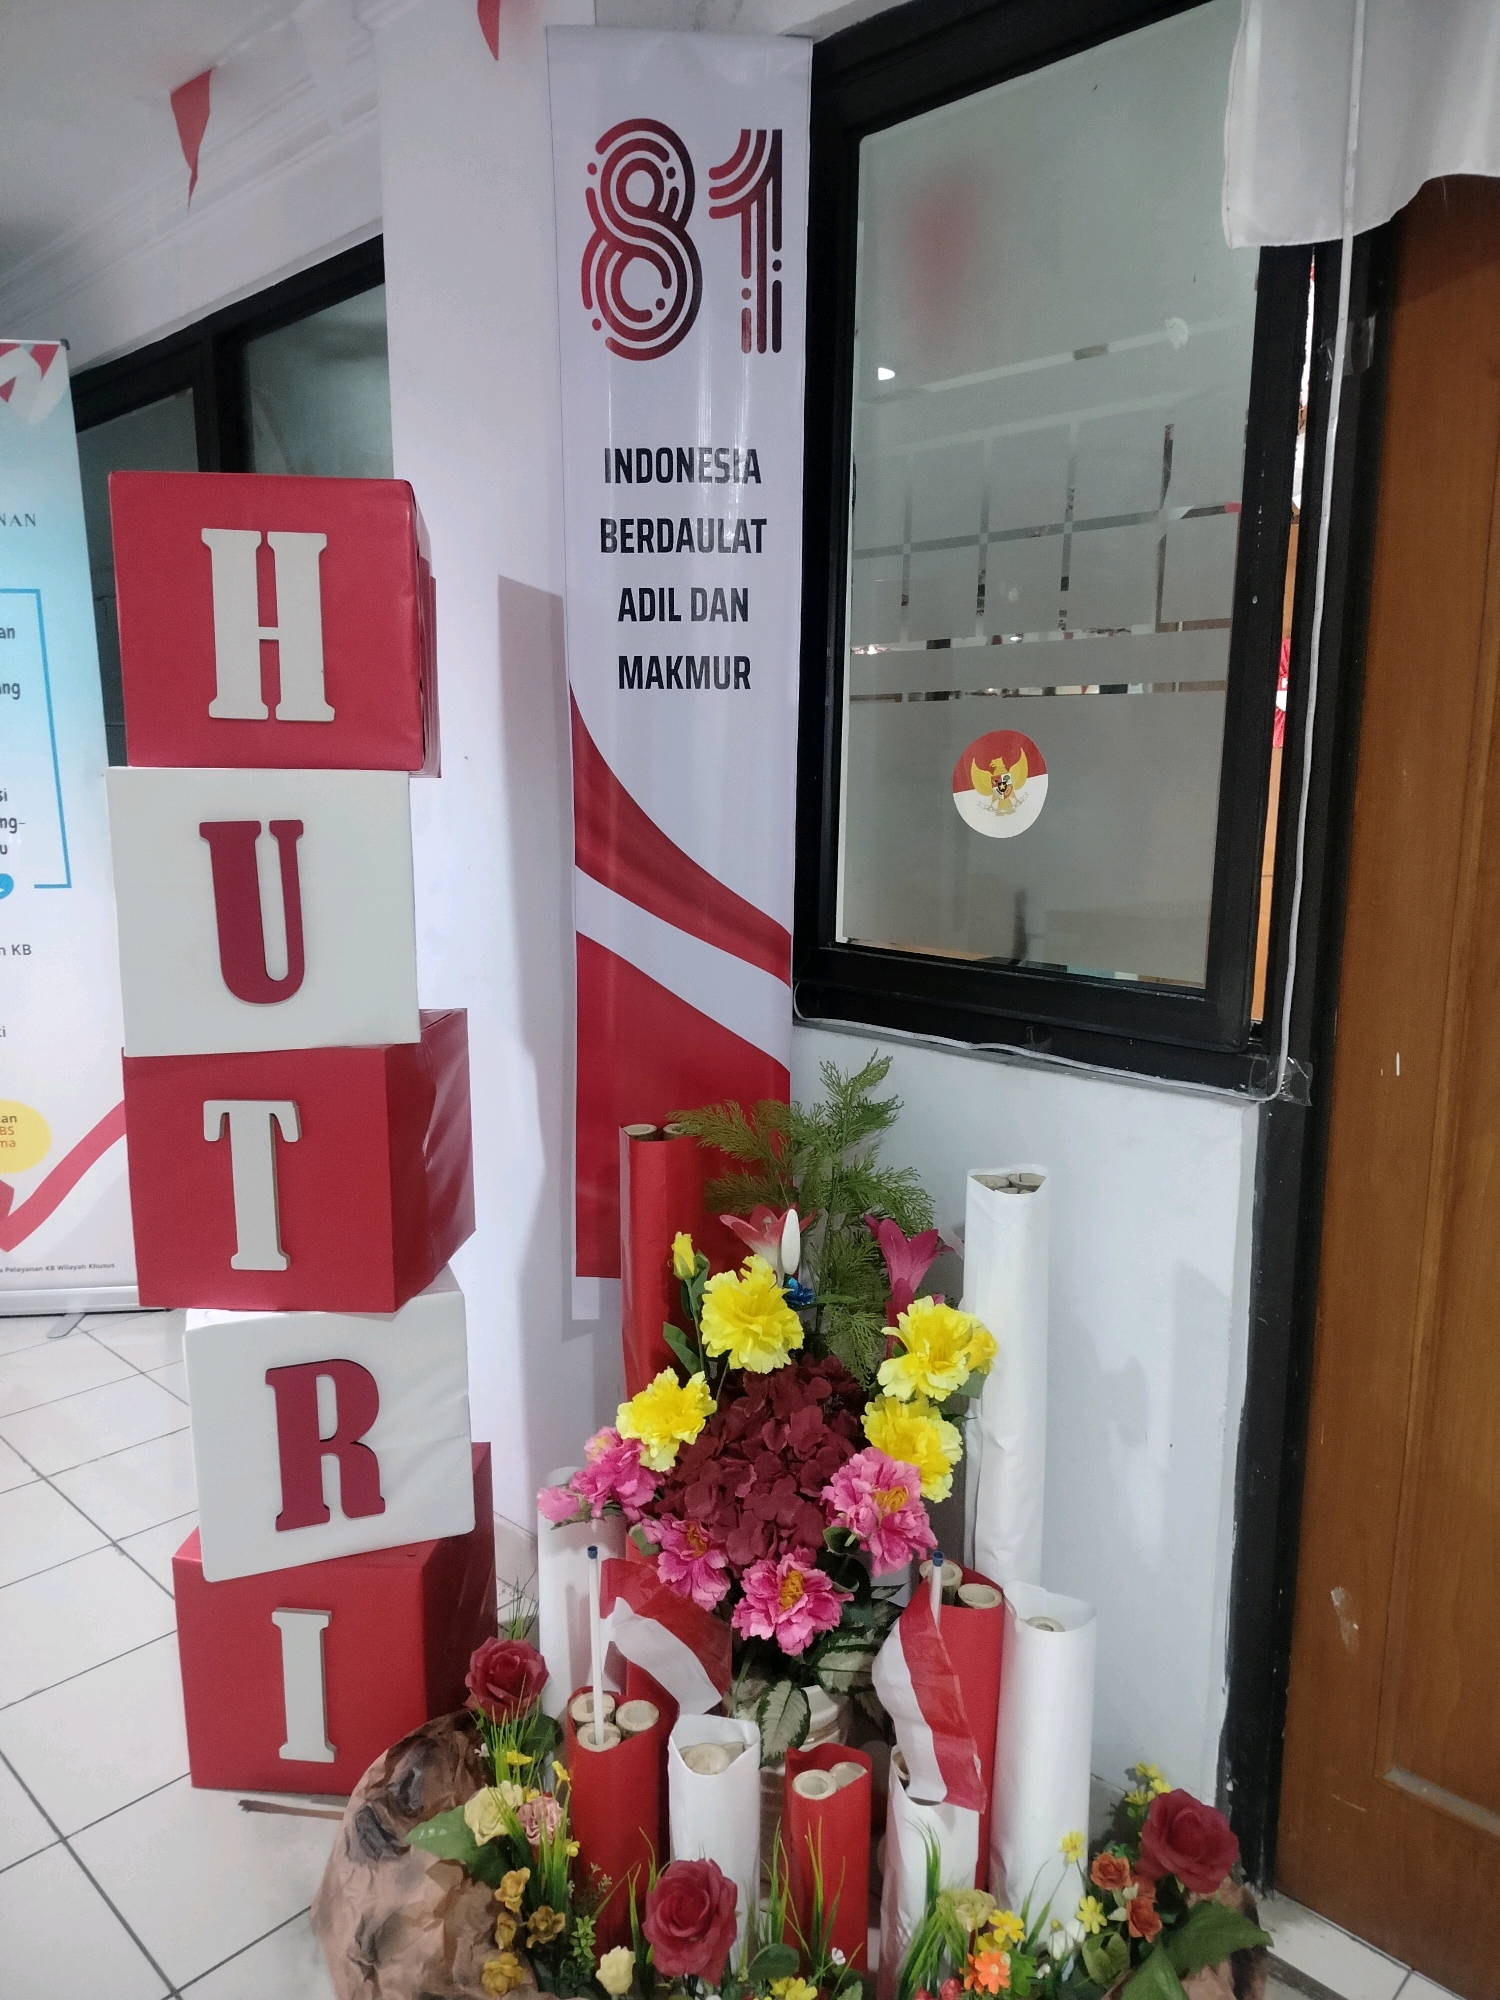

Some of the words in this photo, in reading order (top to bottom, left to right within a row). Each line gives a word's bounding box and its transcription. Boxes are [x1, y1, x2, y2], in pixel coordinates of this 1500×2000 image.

[581, 118, 783, 361] 81
[604, 447, 762, 484] INDONESIA
[600, 517, 767, 554] BERDAULAT
[618, 587, 681, 622] ADIL
[690, 587, 748, 622] DAN
[618, 655, 751, 690] MAKMUR
[11, 944, 31, 956] KB
[5, 1266, 43, 1274] Pelayanan
[57, 1263, 86, 1271] Wilayah
